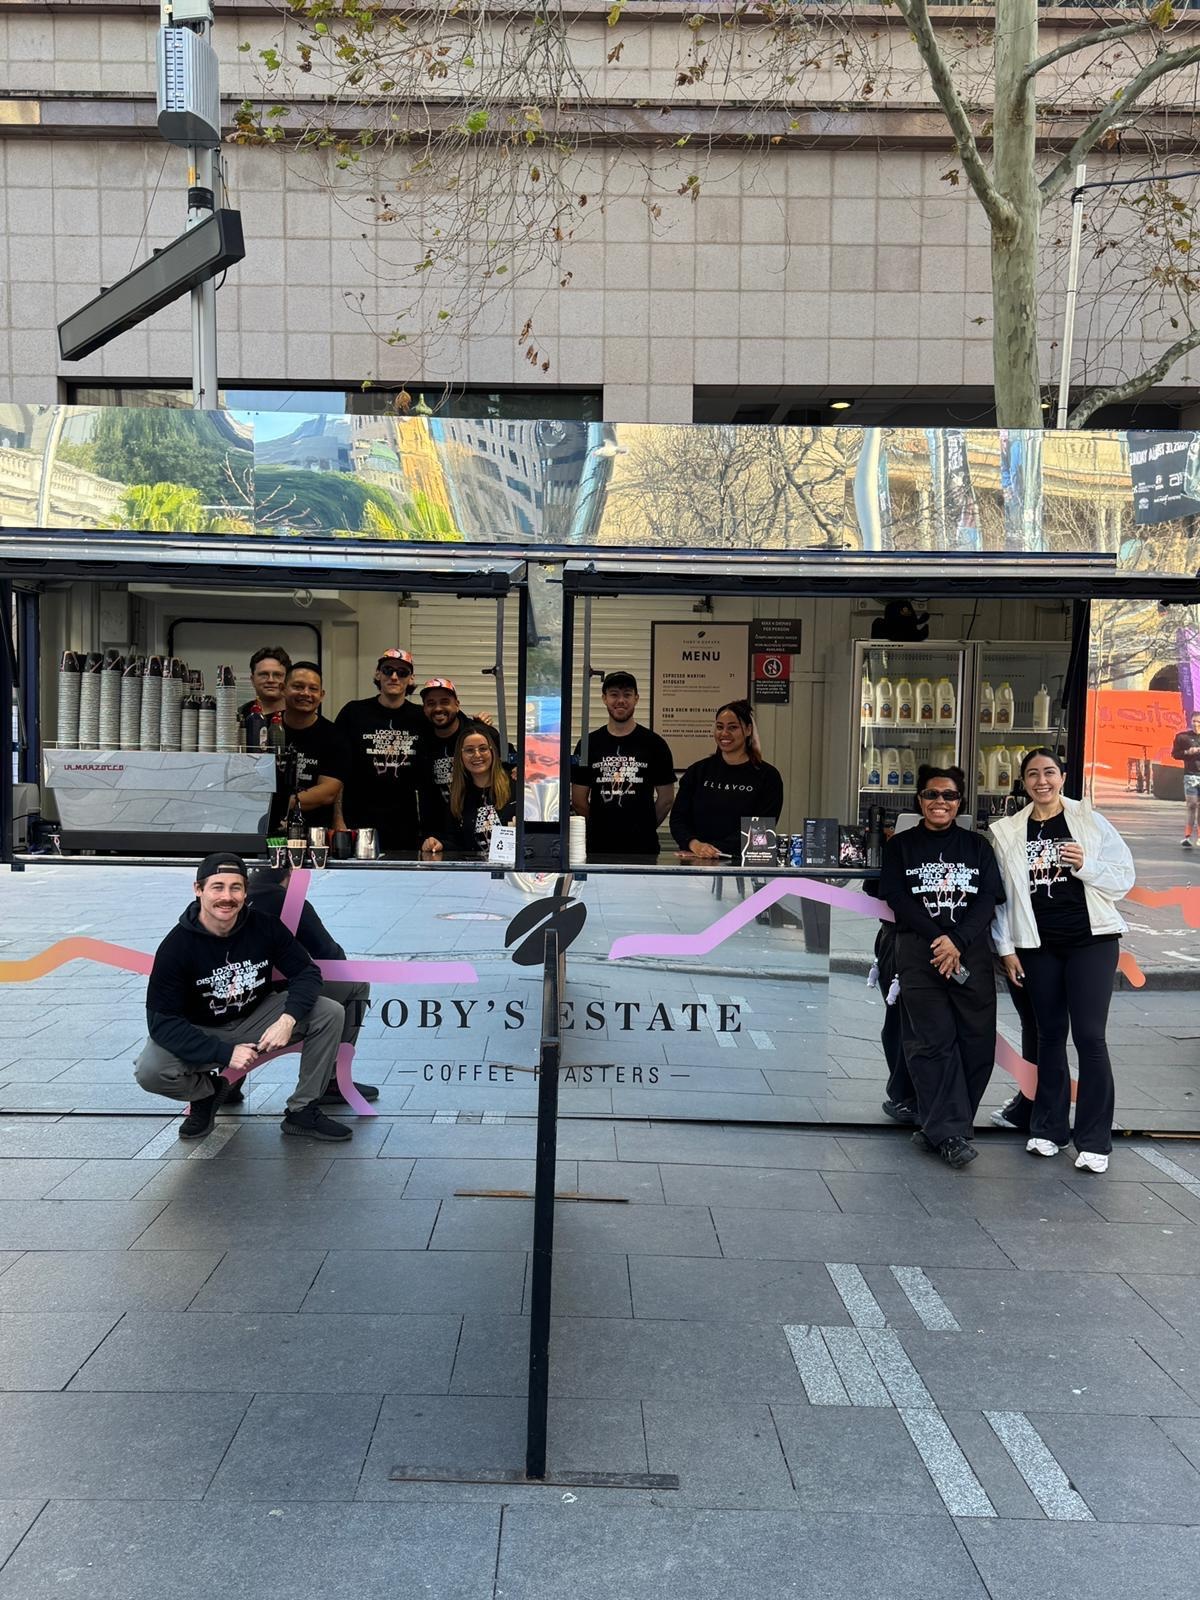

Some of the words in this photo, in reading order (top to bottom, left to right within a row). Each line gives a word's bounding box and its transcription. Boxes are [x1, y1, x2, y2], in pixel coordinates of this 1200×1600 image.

[682, 651, 720, 661] MENU
[212, 962, 241, 976] LOCKED
[559, 1002, 742, 1032] ESTATE
[424, 1064, 514, 1082] COFFEE
[534, 1066, 659, 1084] RASTERS
